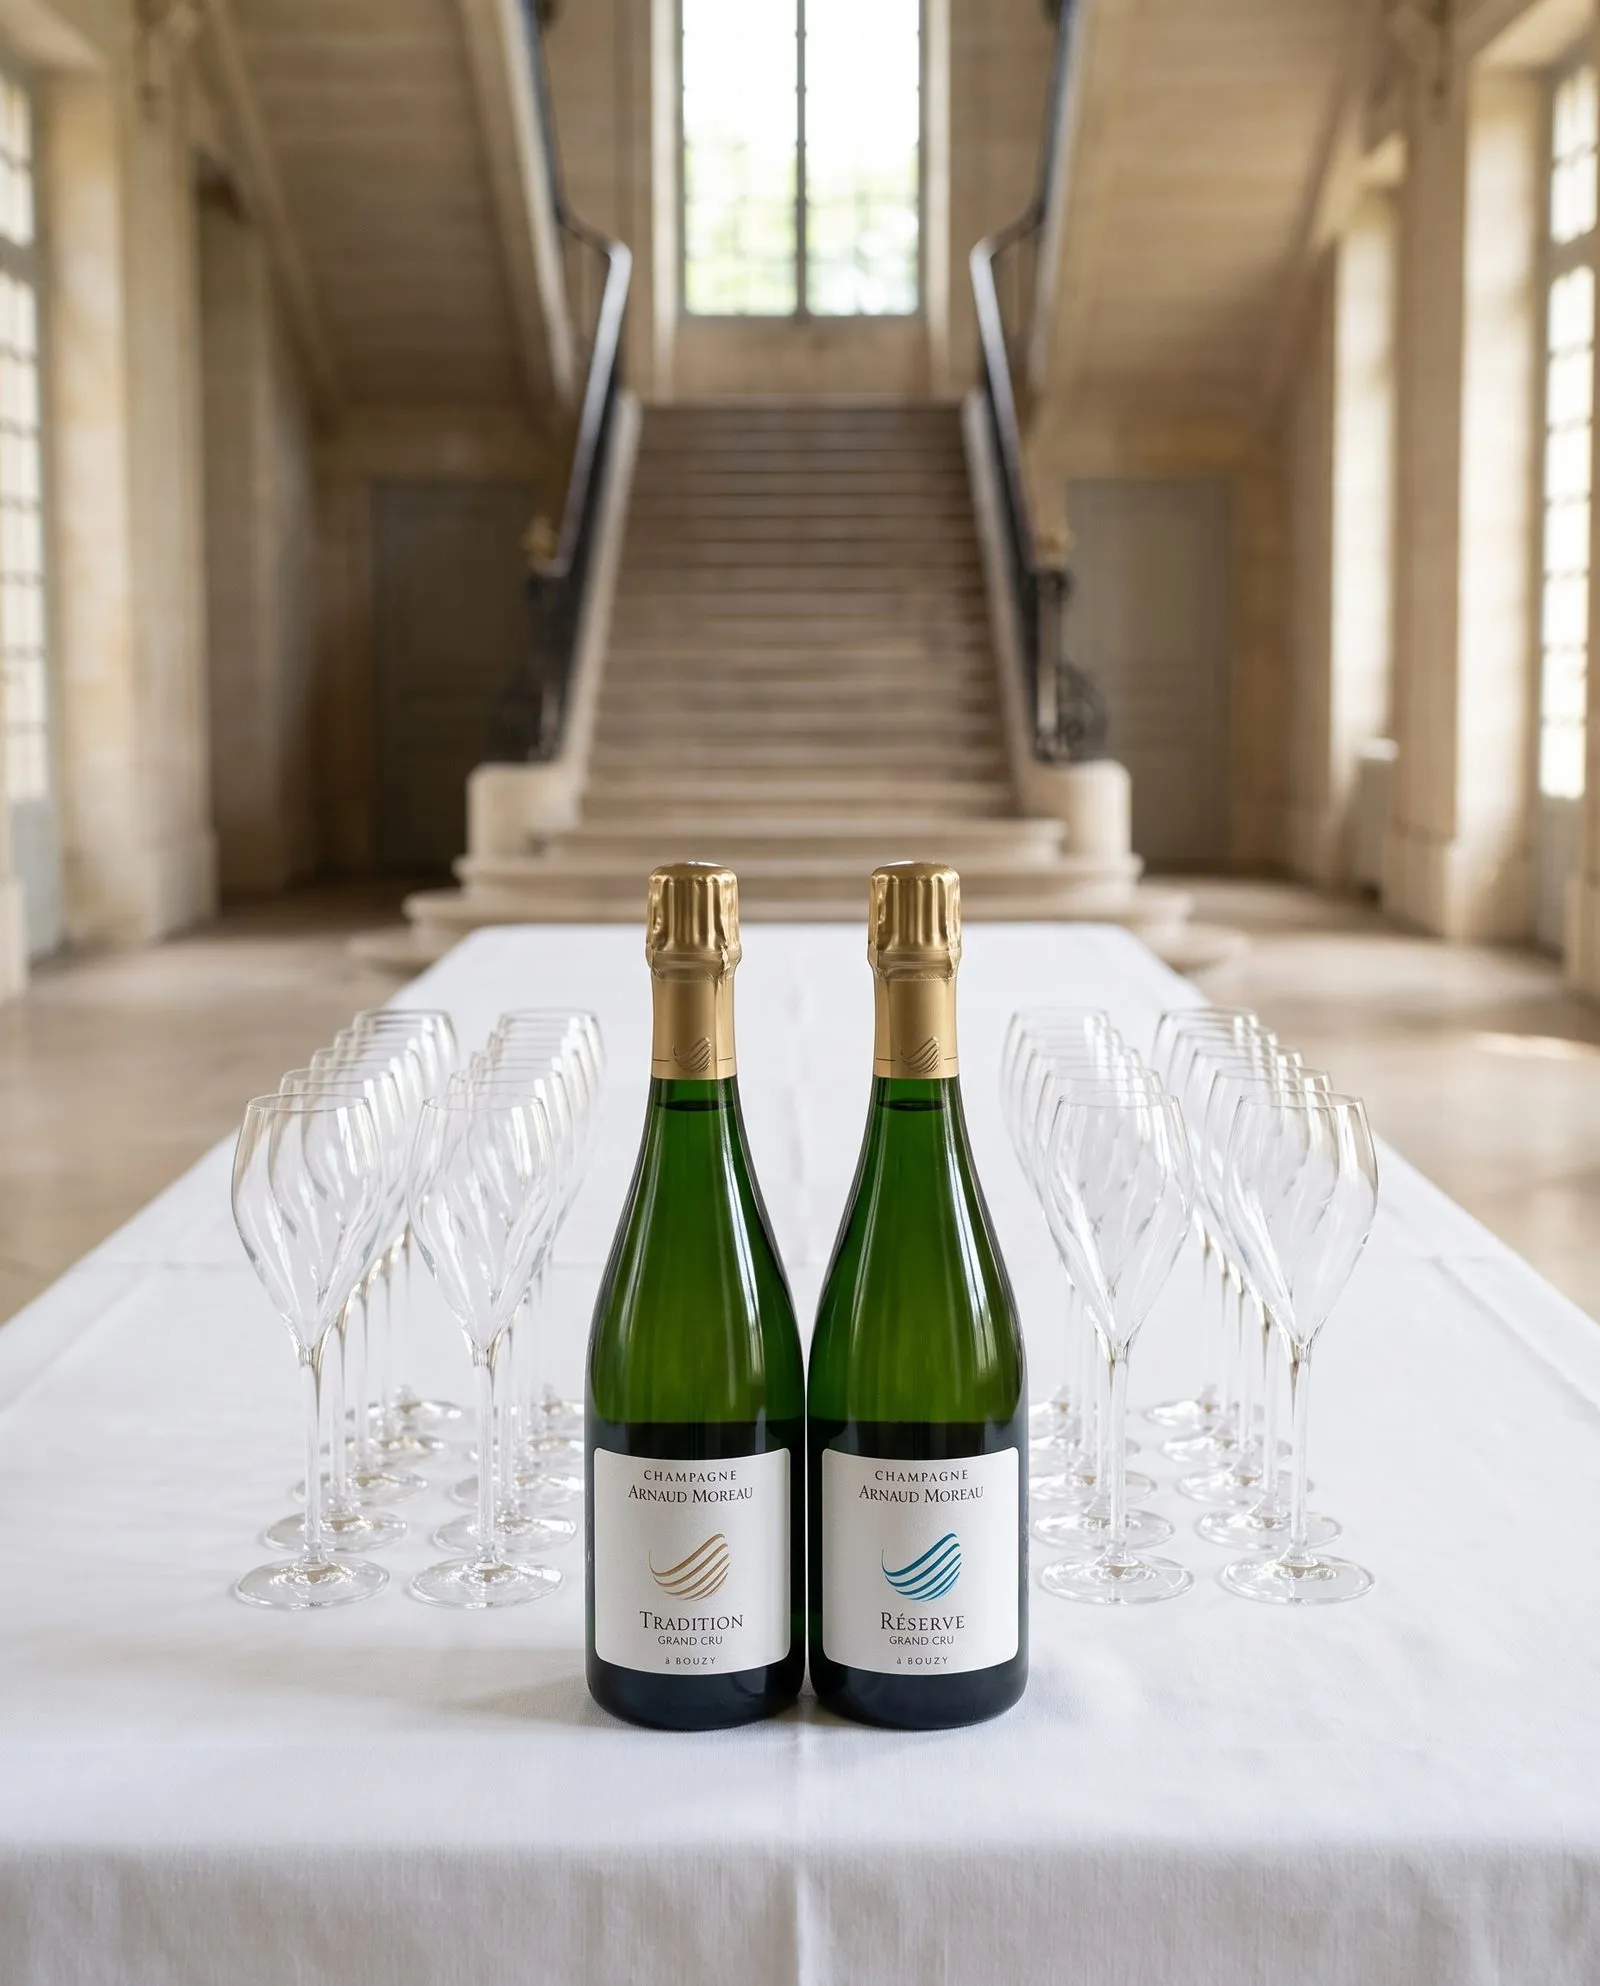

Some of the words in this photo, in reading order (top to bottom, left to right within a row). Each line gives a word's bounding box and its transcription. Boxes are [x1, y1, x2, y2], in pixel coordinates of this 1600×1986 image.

[643, 1469, 737, 1483] CHAMPAGNE
[874, 1469, 968, 1483] CHAMPAGNE
[657, 1635, 698, 1646] GRAND
[700, 1635, 723, 1646] CRU
[889, 1635, 929, 1646] GRAND
[932, 1635, 955, 1646] CRU
[676, 1656, 716, 1665] BOUZY
[907, 1656, 948, 1665] BOUZY
